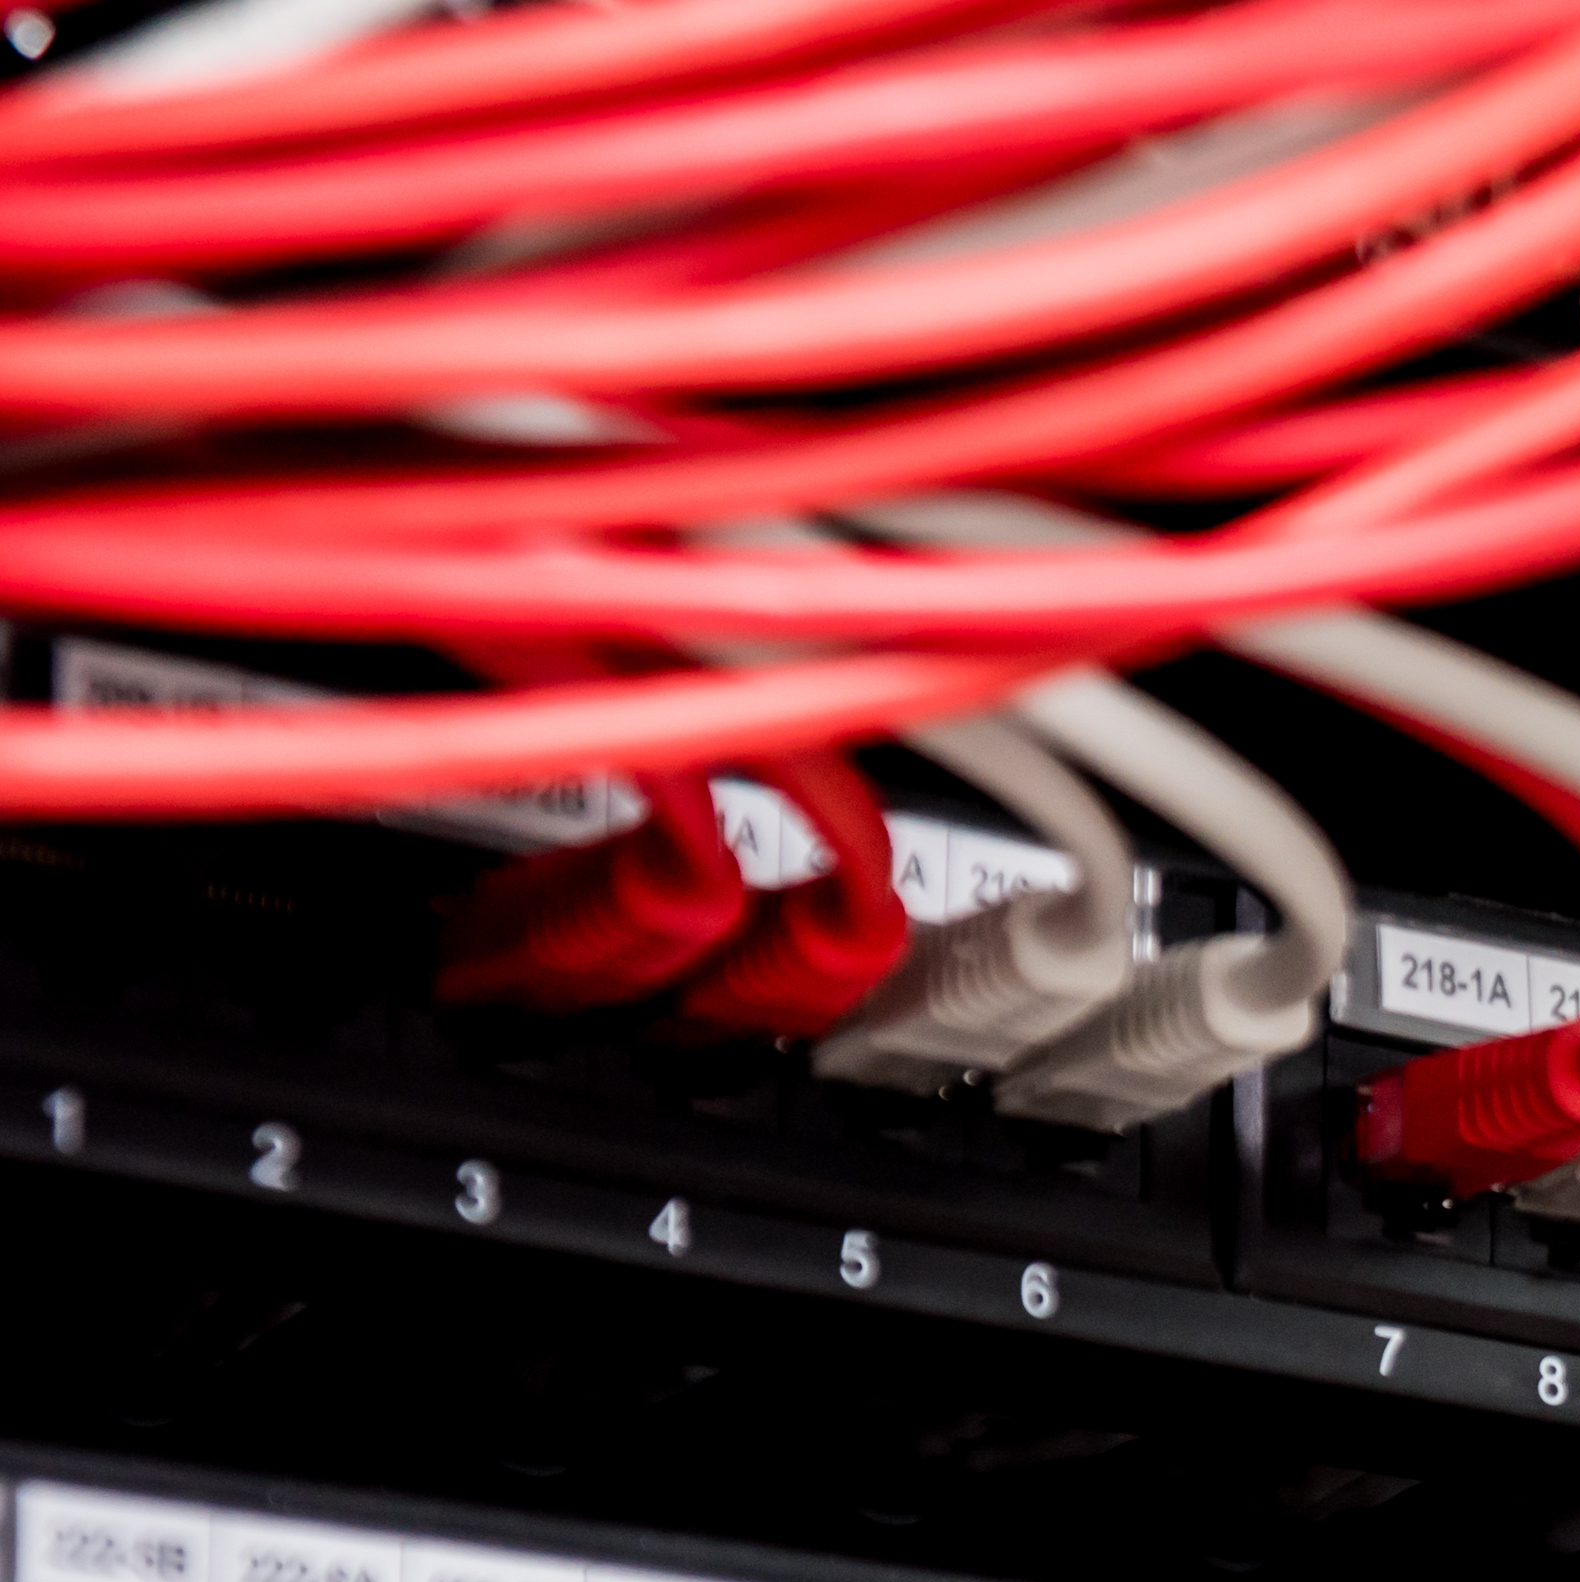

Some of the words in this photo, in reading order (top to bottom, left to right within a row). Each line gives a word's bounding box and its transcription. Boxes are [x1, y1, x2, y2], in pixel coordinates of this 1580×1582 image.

[1400, 952, 1514, 1011] 218-1A
[45, 1089, 83, 1153] 1
[250, 1124, 297, 1192] 2
[454, 1162, 498, 1225] 3
[649, 1200, 688, 1256] 4
[839, 1231, 879, 1289] 5
[1020, 1263, 1057, 1319] 6
[1374, 1325, 1406, 1377] 7
[1537, 1355, 1569, 1406] 8
